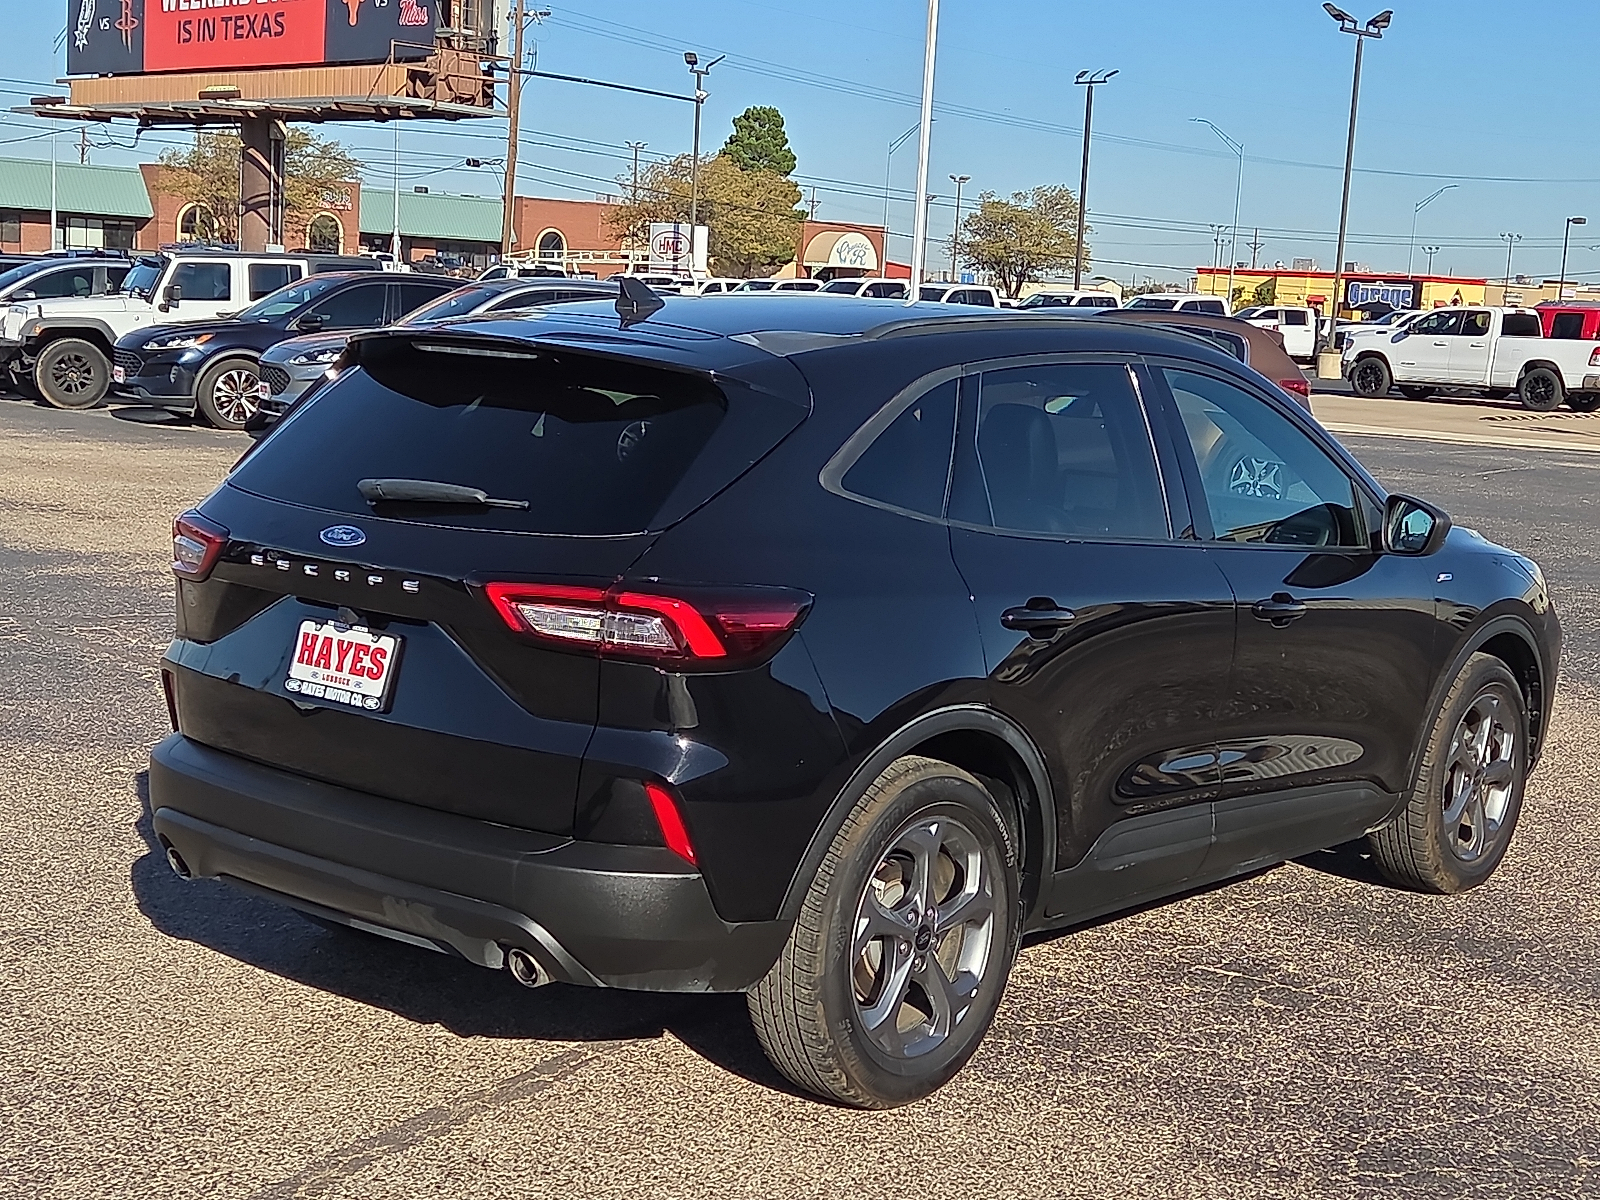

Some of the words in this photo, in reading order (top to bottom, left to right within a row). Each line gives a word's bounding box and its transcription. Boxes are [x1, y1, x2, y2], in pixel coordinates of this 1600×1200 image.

[399, 0, 428, 26] Miss
[177, 20, 192, 44] IS
[197, 17, 216, 43] IN
[221, 12, 286, 41] TEXAS
[659, 236, 682, 254] HMC
[1349, 283, 1413, 310] Garage
[251, 554, 420, 594] ESCAPE
[297, 631, 388, 681] HAYES
